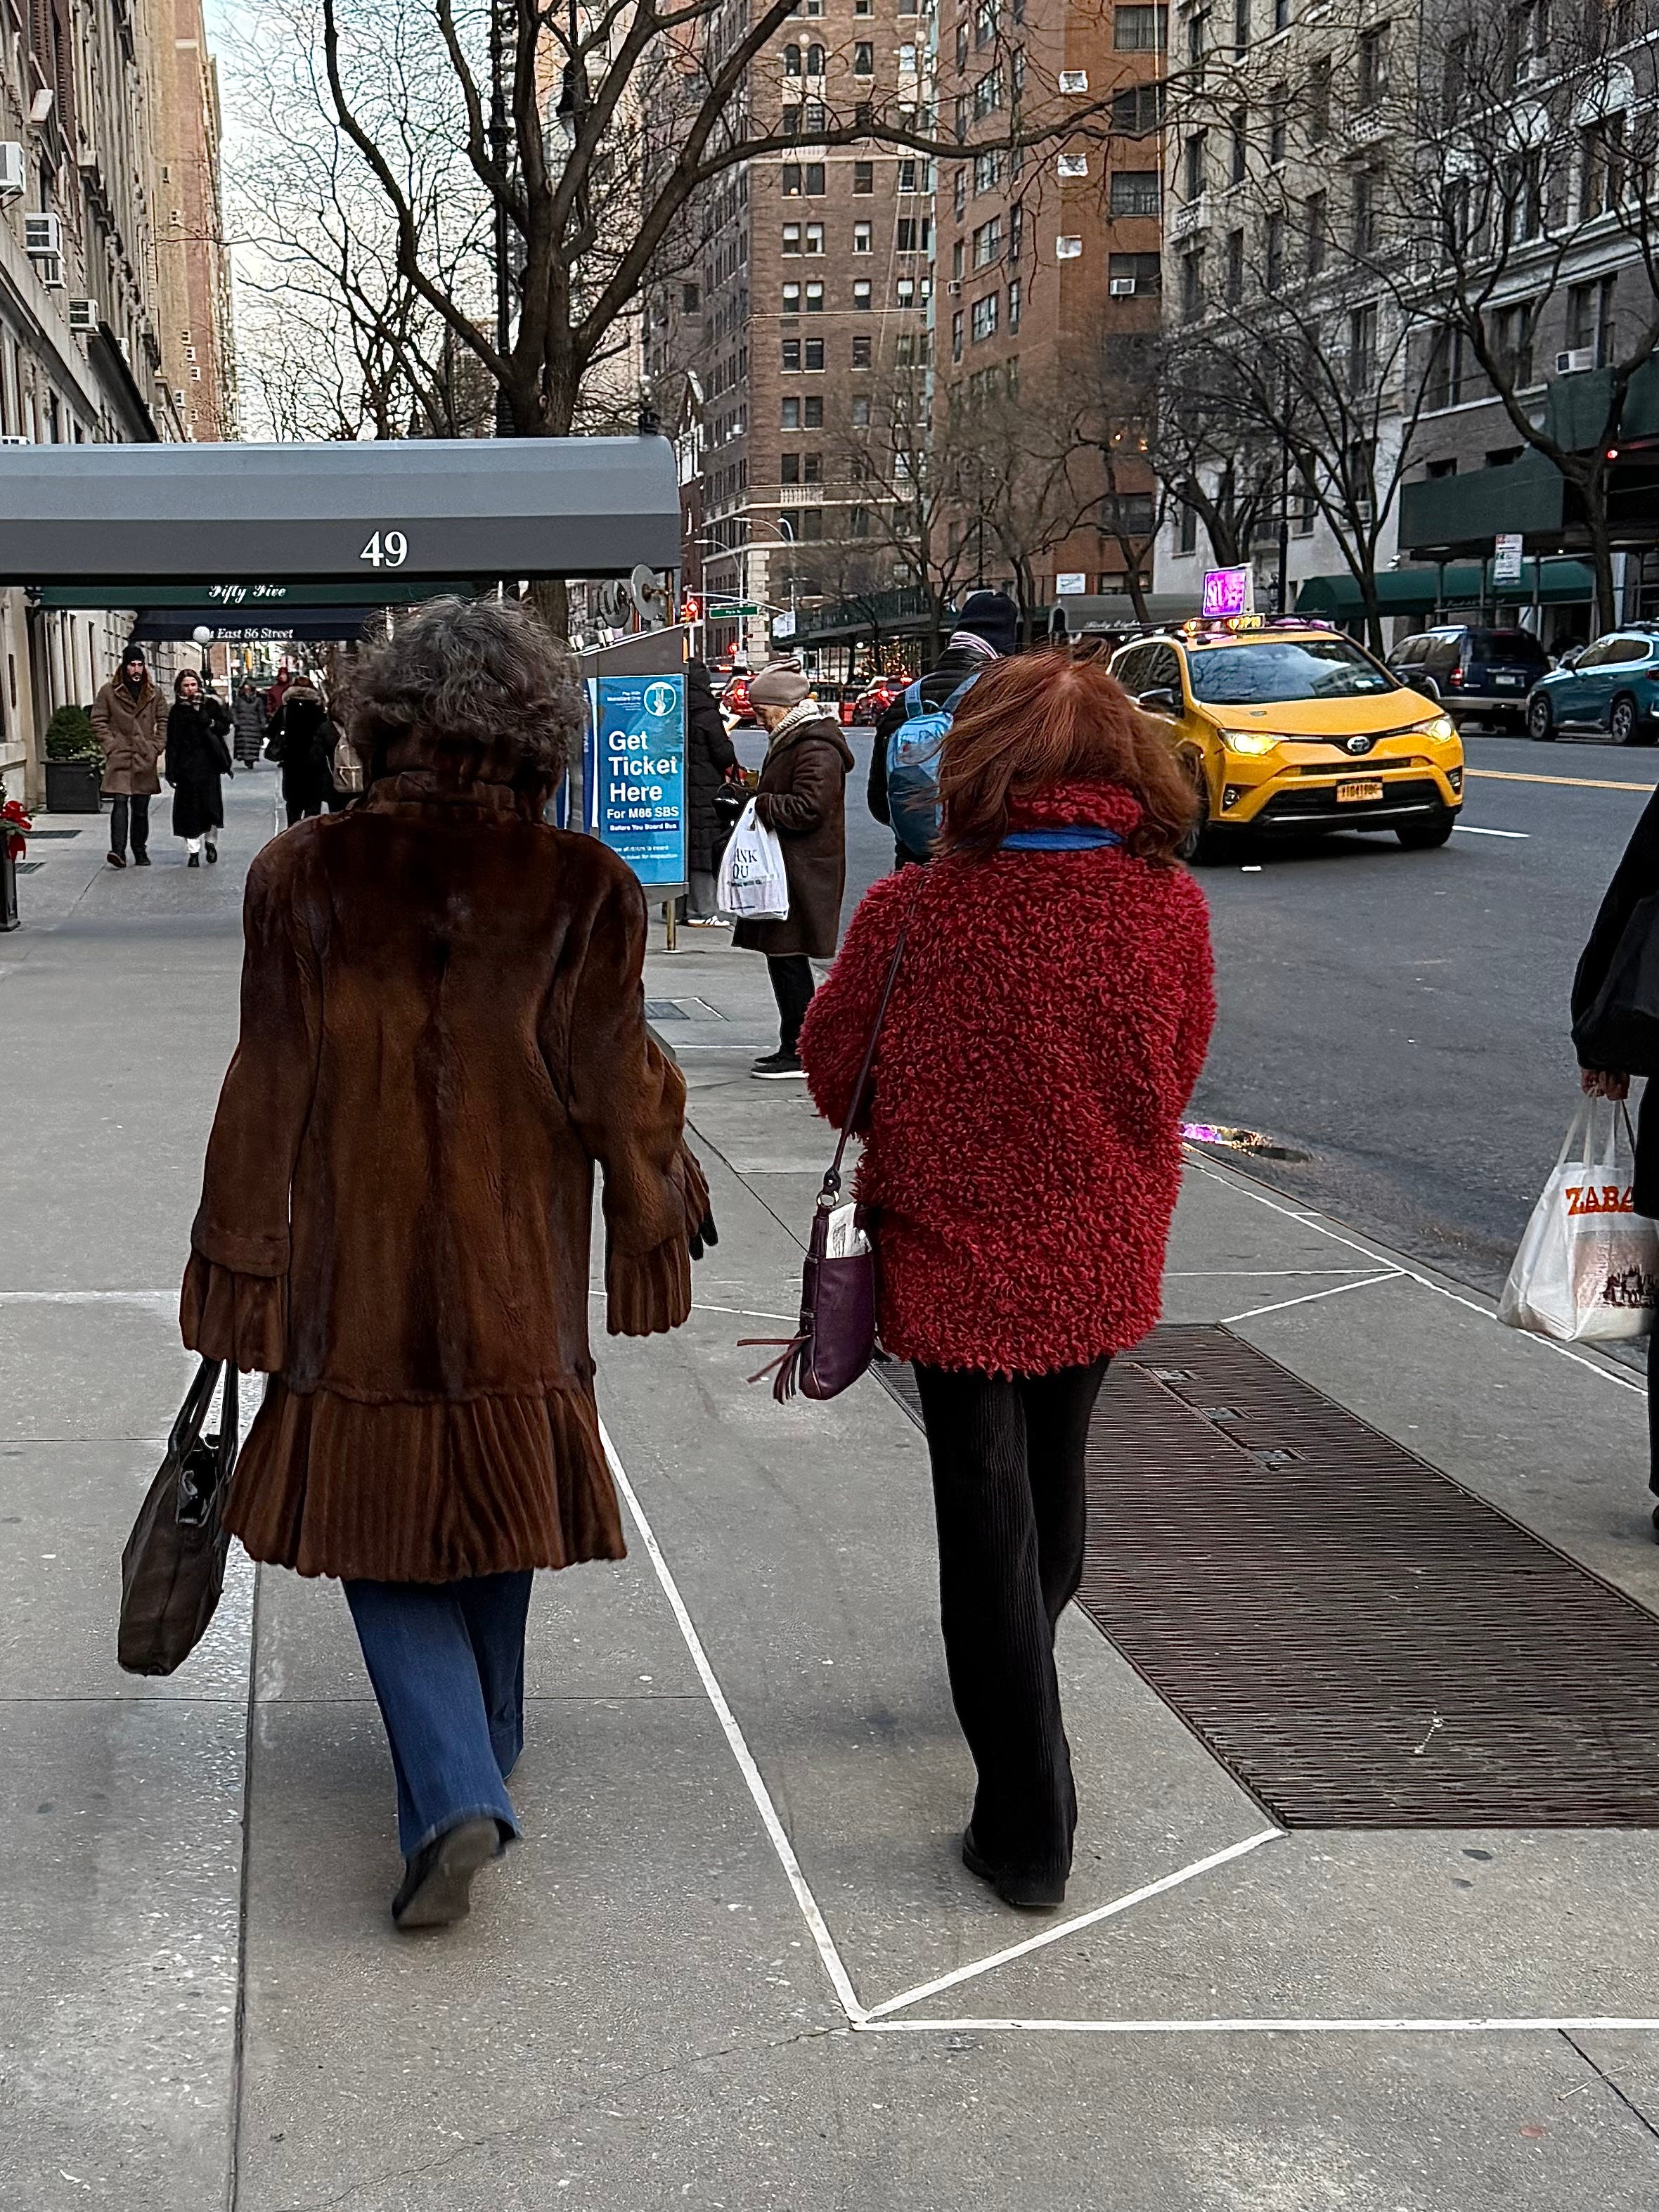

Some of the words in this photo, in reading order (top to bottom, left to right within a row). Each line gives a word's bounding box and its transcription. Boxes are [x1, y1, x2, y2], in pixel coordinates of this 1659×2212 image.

[359, 530, 408, 567] 49
[208, 584, 247, 604] Fifty
[252, 584, 287, 597] Five
[217, 628, 242, 638] East
[243, 628, 259, 638] 86
[260, 628, 294, 638] Street
[609, 731, 648, 751] Get
[607, 755, 678, 776] Ticket
[609, 782, 663, 802] Here
[607, 809, 626, 819] For
[628, 807, 652, 818] M86
[654, 806, 680, 818] SBS
[732, 863, 749, 879] OU
[1565, 1185, 1634, 1216] ZABA
